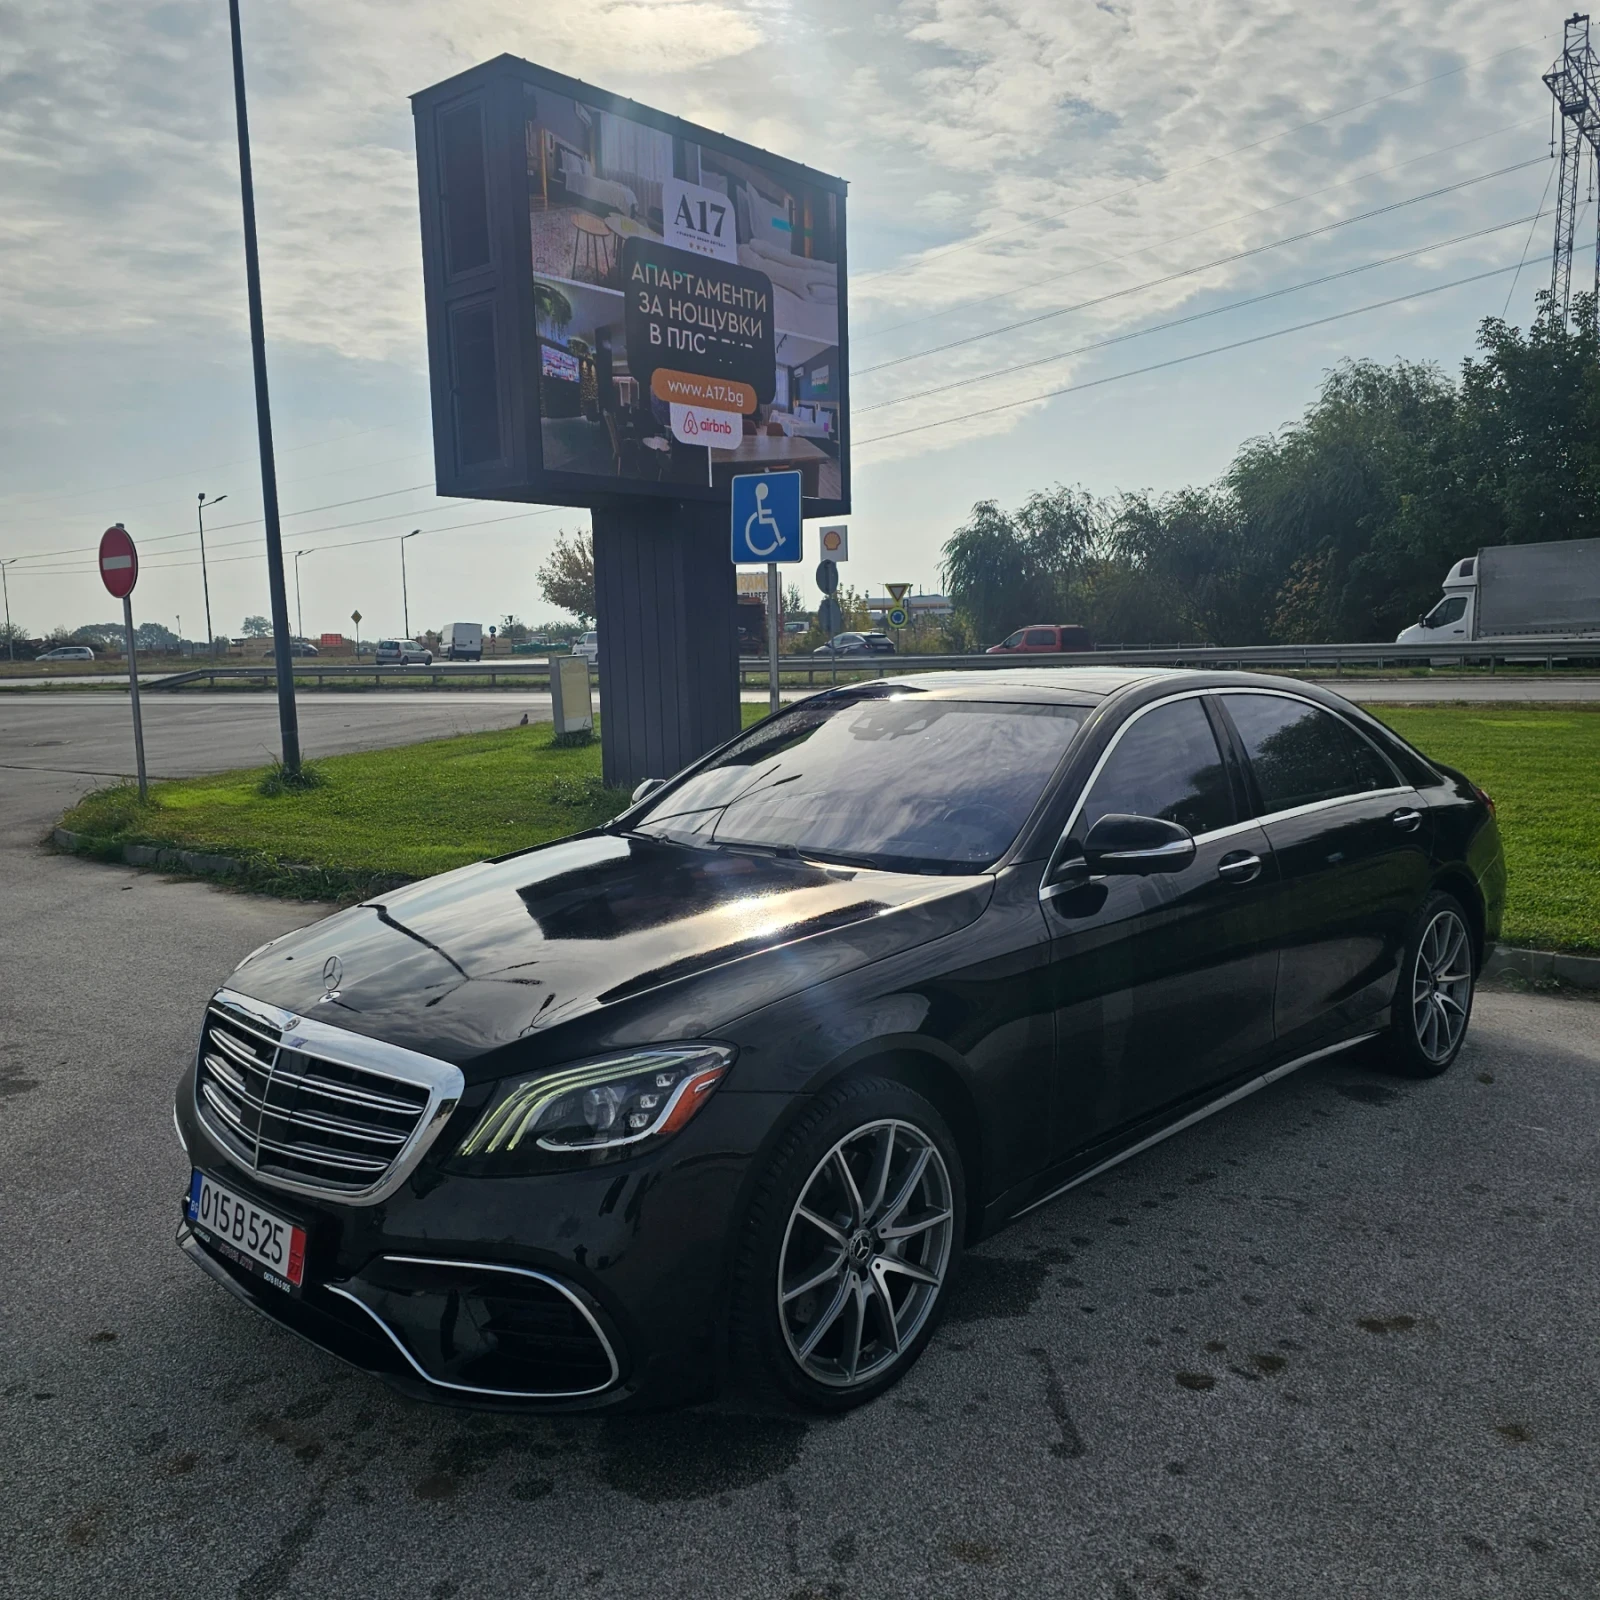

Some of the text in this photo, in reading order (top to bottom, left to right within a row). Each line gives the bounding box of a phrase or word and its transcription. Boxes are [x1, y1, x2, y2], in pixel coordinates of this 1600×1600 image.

[674, 194, 726, 237] A17
[632, 261, 766, 312] АПАРТАМЕНТИ
[639, 291, 762, 339] ЗА НОЩУВКИ
[650, 322, 662, 345] В
[668, 380, 744, 407] www.A17.bg
[700, 418, 731, 434] airbnb
[190, 1200, 199, 1213] BG
